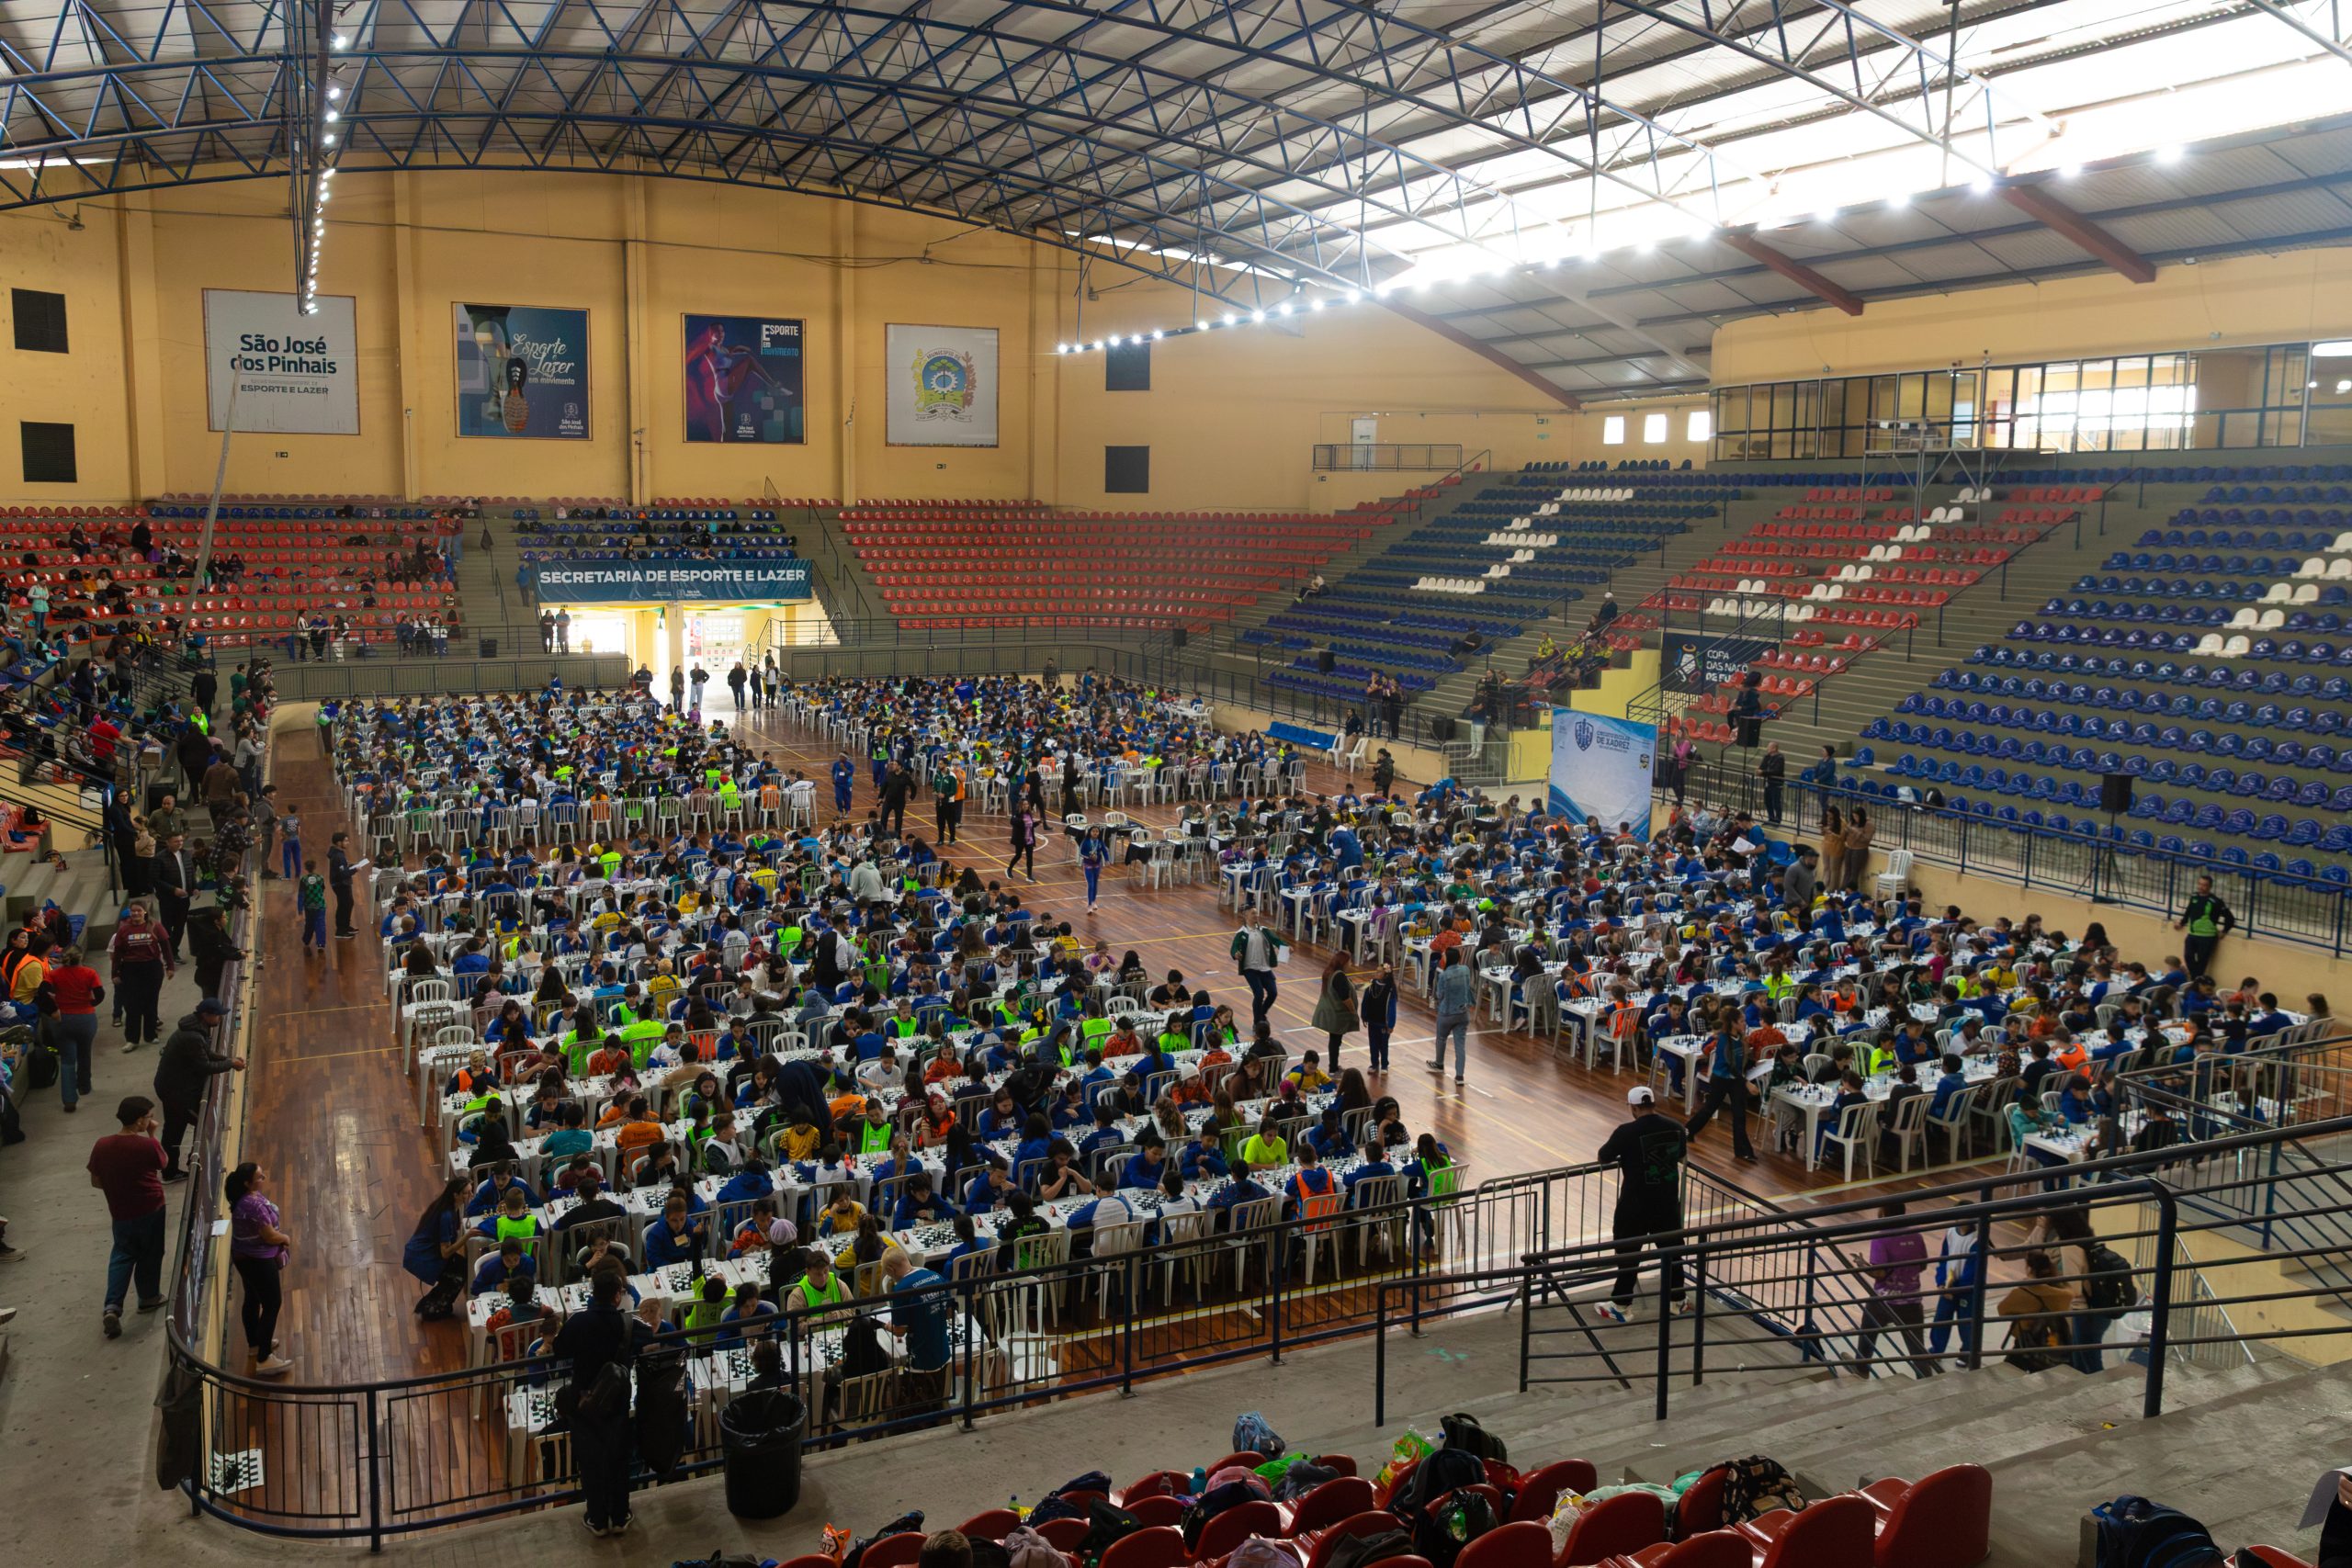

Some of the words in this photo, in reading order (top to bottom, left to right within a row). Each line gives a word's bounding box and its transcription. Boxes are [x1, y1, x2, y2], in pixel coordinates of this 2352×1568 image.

[762, 324, 799, 341] ESPORTE
[240, 334, 279, 353] São
[283, 336, 326, 355] José
[511, 333, 567, 360] Esporte
[230, 353, 265, 371] dos
[268, 355, 337, 374] Pinhais
[529, 352, 574, 378] Lazer
[241, 384, 288, 393] ESPORTE
[298, 386, 329, 395] LAZER
[540, 570, 643, 583] SECRETARIA
[646, 570, 667, 582] DE
[670, 570, 741, 582] ESPORTE
[745, 570, 754, 581] E
[757, 570, 806, 581] LAZER
[1707, 649, 1729, 660] COPA
[1706, 660, 1724, 671] DAS
[1705, 672, 1717, 682] DE
[1596, 736, 1606, 745] DE
[1606, 739, 1630, 750] XADREZ
